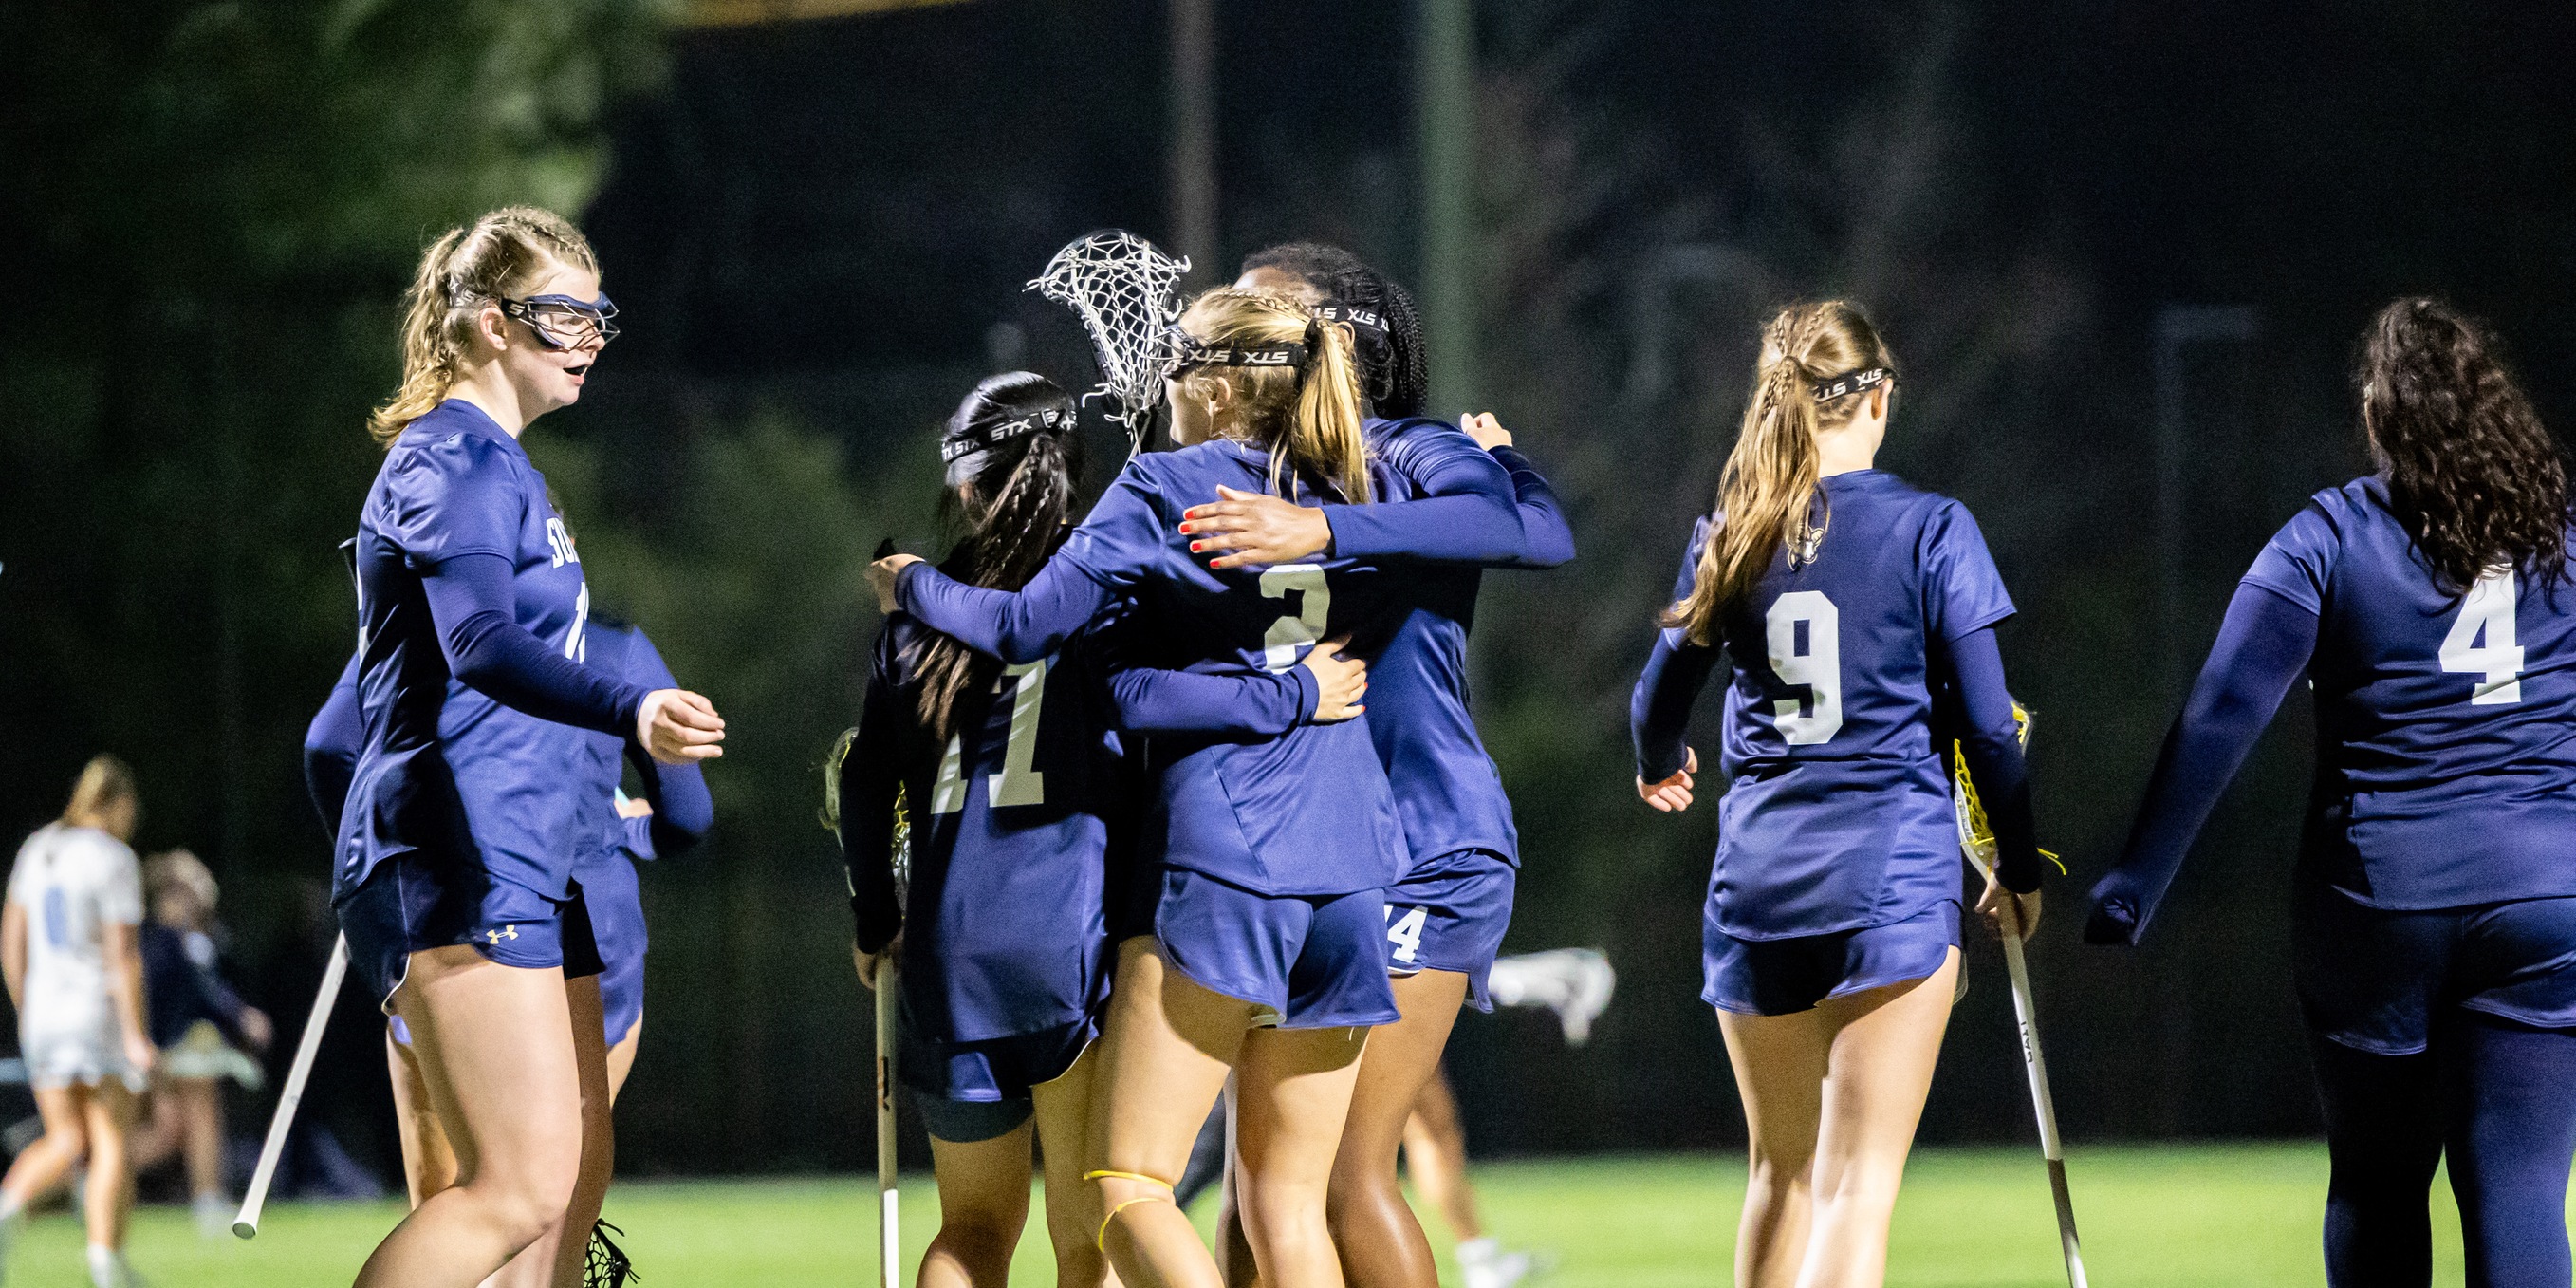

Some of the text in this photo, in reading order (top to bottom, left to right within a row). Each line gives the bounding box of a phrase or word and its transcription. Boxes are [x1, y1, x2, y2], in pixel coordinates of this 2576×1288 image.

[1347, 308, 1377, 326] STX
[1188, 348, 1288, 364] STX STX
[1855, 368, 1883, 387] STX
[991, 418, 1033, 442] STX
[1259, 563, 1331, 676] 2
[2438, 562, 2525, 705] 4
[1766, 590, 1844, 745] 9
[1383, 904, 1429, 963] 4
